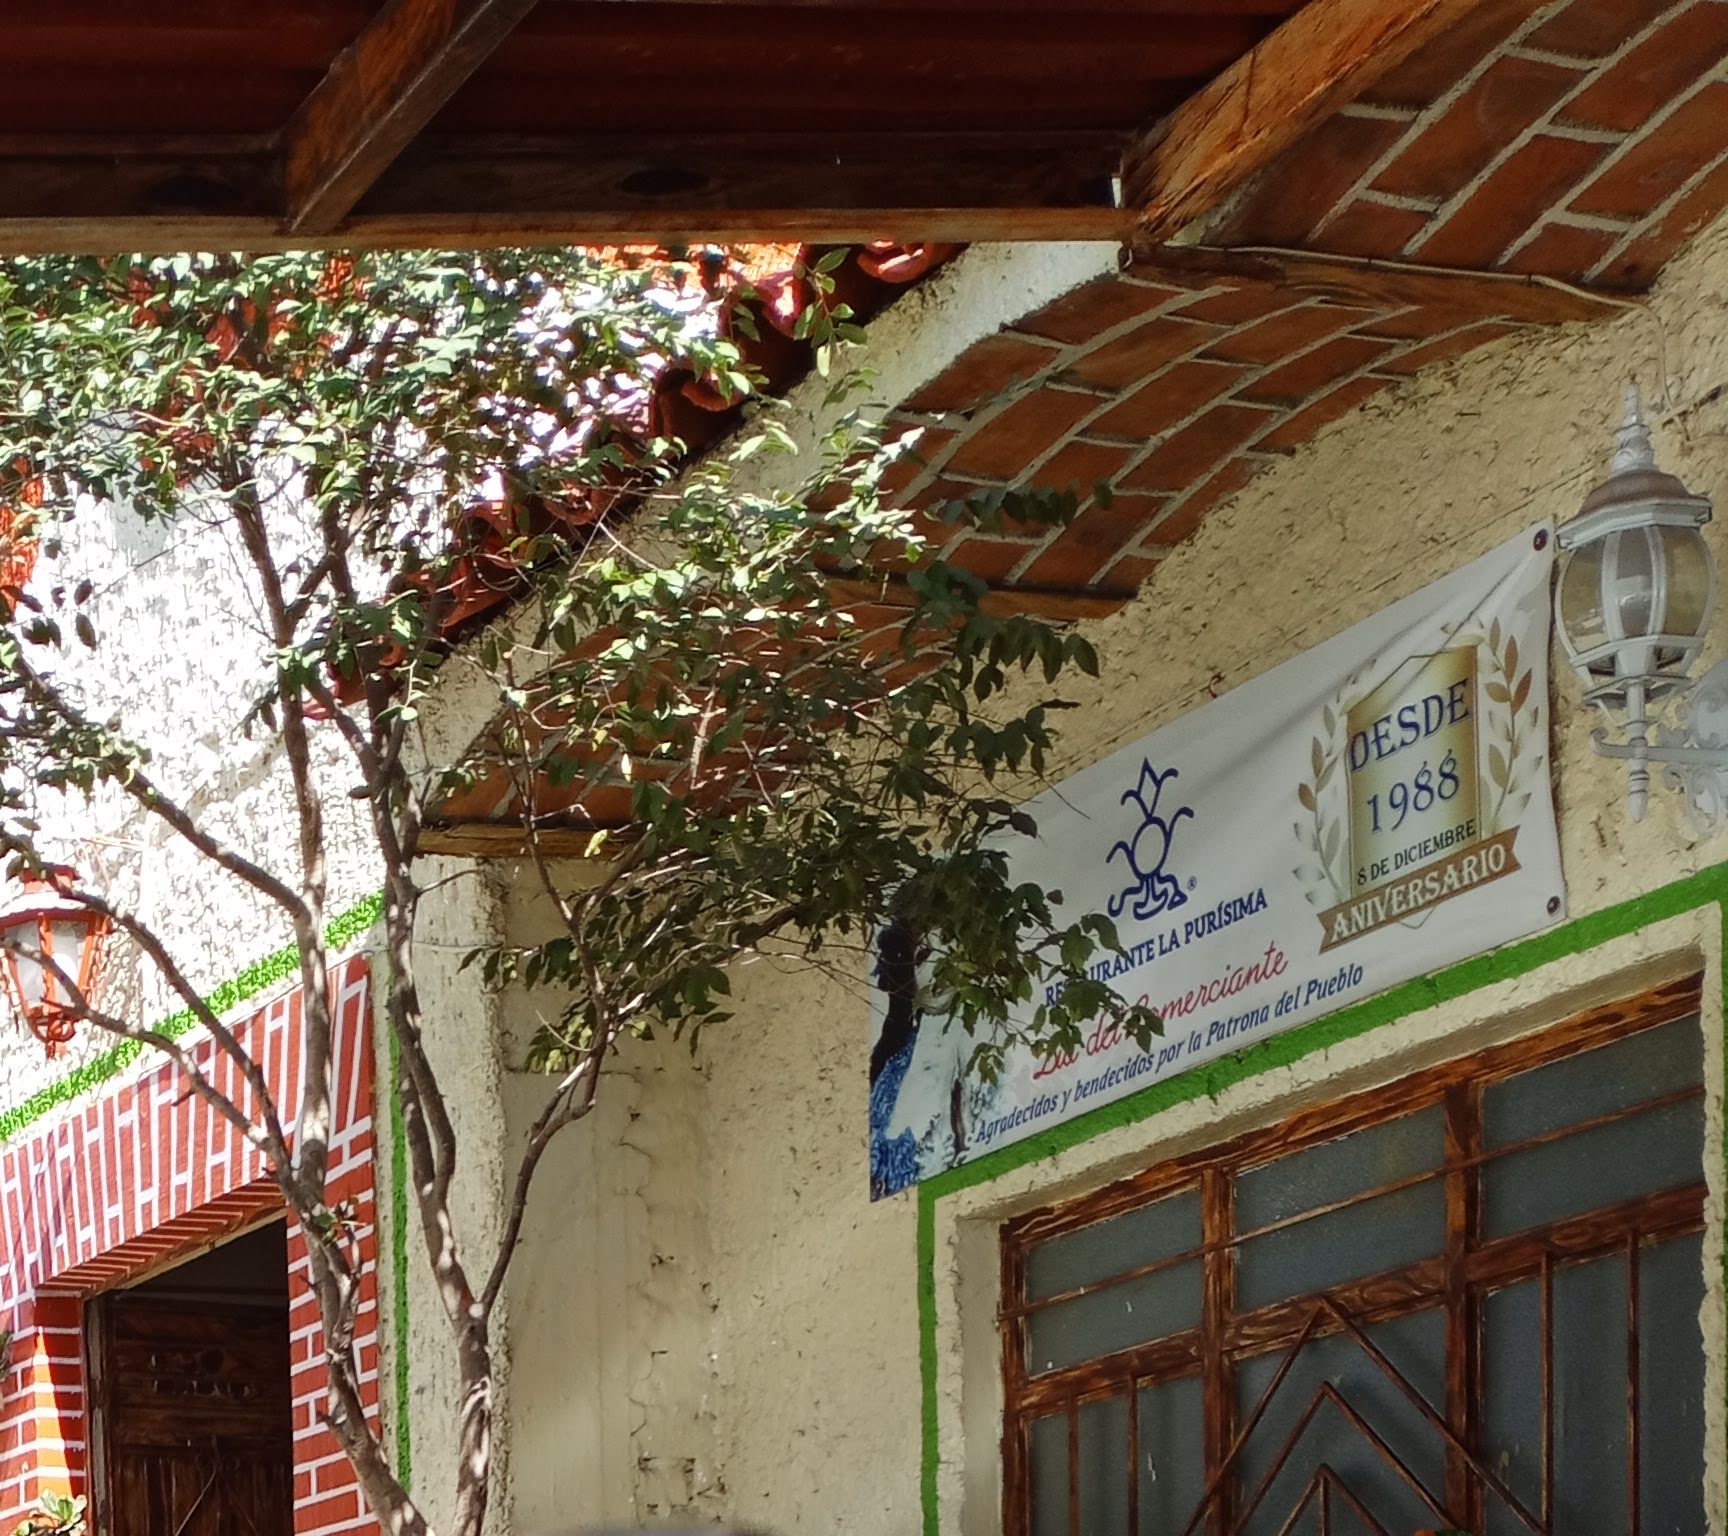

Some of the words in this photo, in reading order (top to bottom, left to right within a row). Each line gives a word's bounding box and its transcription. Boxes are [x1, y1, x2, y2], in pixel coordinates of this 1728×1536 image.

[1349, 678, 1472, 772] DESDE
[1366, 749, 1460, 833] 1988
[1330, 842, 1507, 943] ANIVERSARIO
[1357, 865, 1368, 887] 8
[1371, 856, 1390, 881] DE
[1394, 818, 1478, 873] DICIEMBRE
[1158, 932, 1182, 957] LA
[1184, 886, 1269, 946] PURÍSIMA
[976, 1092, 1058, 1144] Agradecidos
[1060, 1087, 1073, 1113] y
[1073, 1053, 1155, 1103] bendecidos
[1155, 1036, 1190, 1074] por
[1186, 1028, 1201, 1053] la
[1206, 1000, 1269, 1048] Patrona
[1275, 985, 1302, 1018] del
[1304, 963, 1364, 1009] Pueblo
